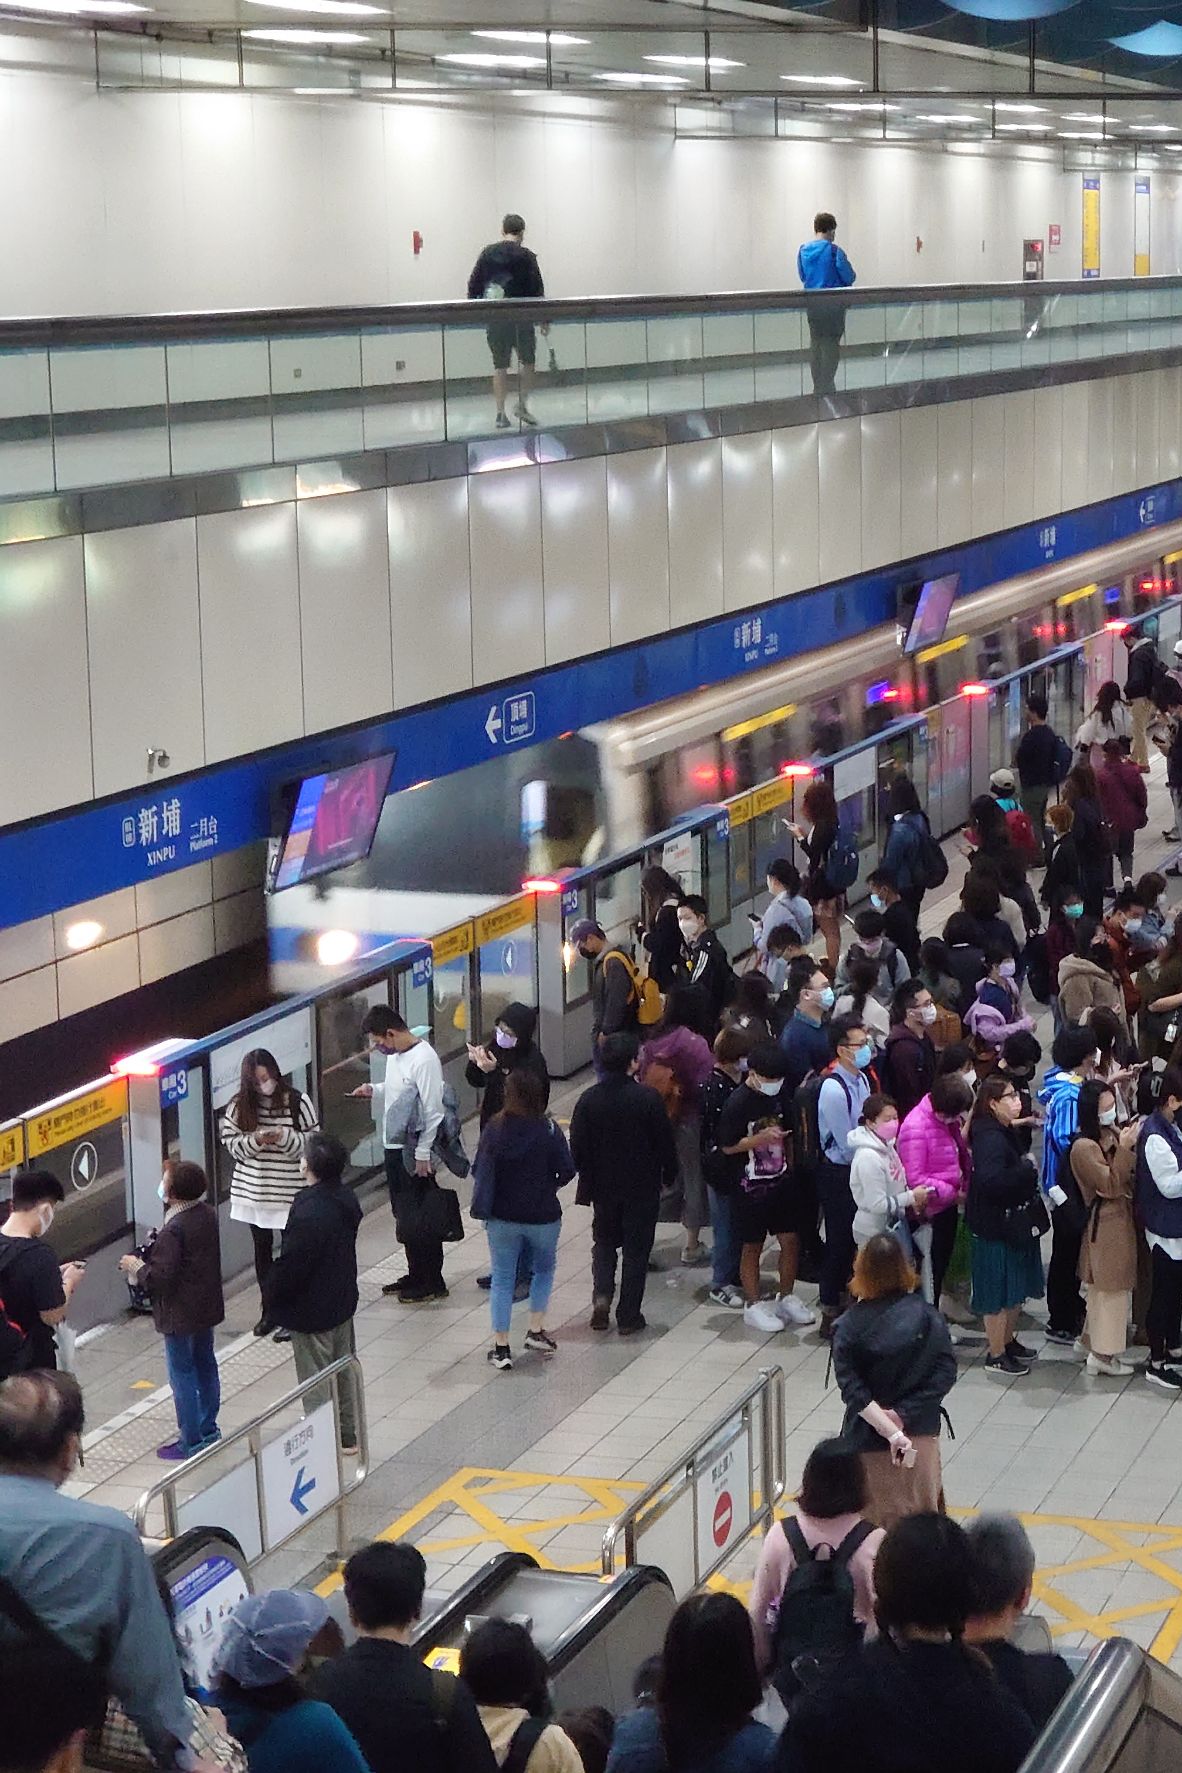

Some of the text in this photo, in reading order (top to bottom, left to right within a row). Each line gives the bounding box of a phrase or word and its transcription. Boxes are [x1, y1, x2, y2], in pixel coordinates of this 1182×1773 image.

[138, 798, 180, 846] 新埔
[190, 815, 218, 840] 二月台
[147, 845, 175, 866] XINPU
[571, 890, 578, 909] 3
[424, 956, 433, 978] 3
[176, 1069, 188, 1095] 3
